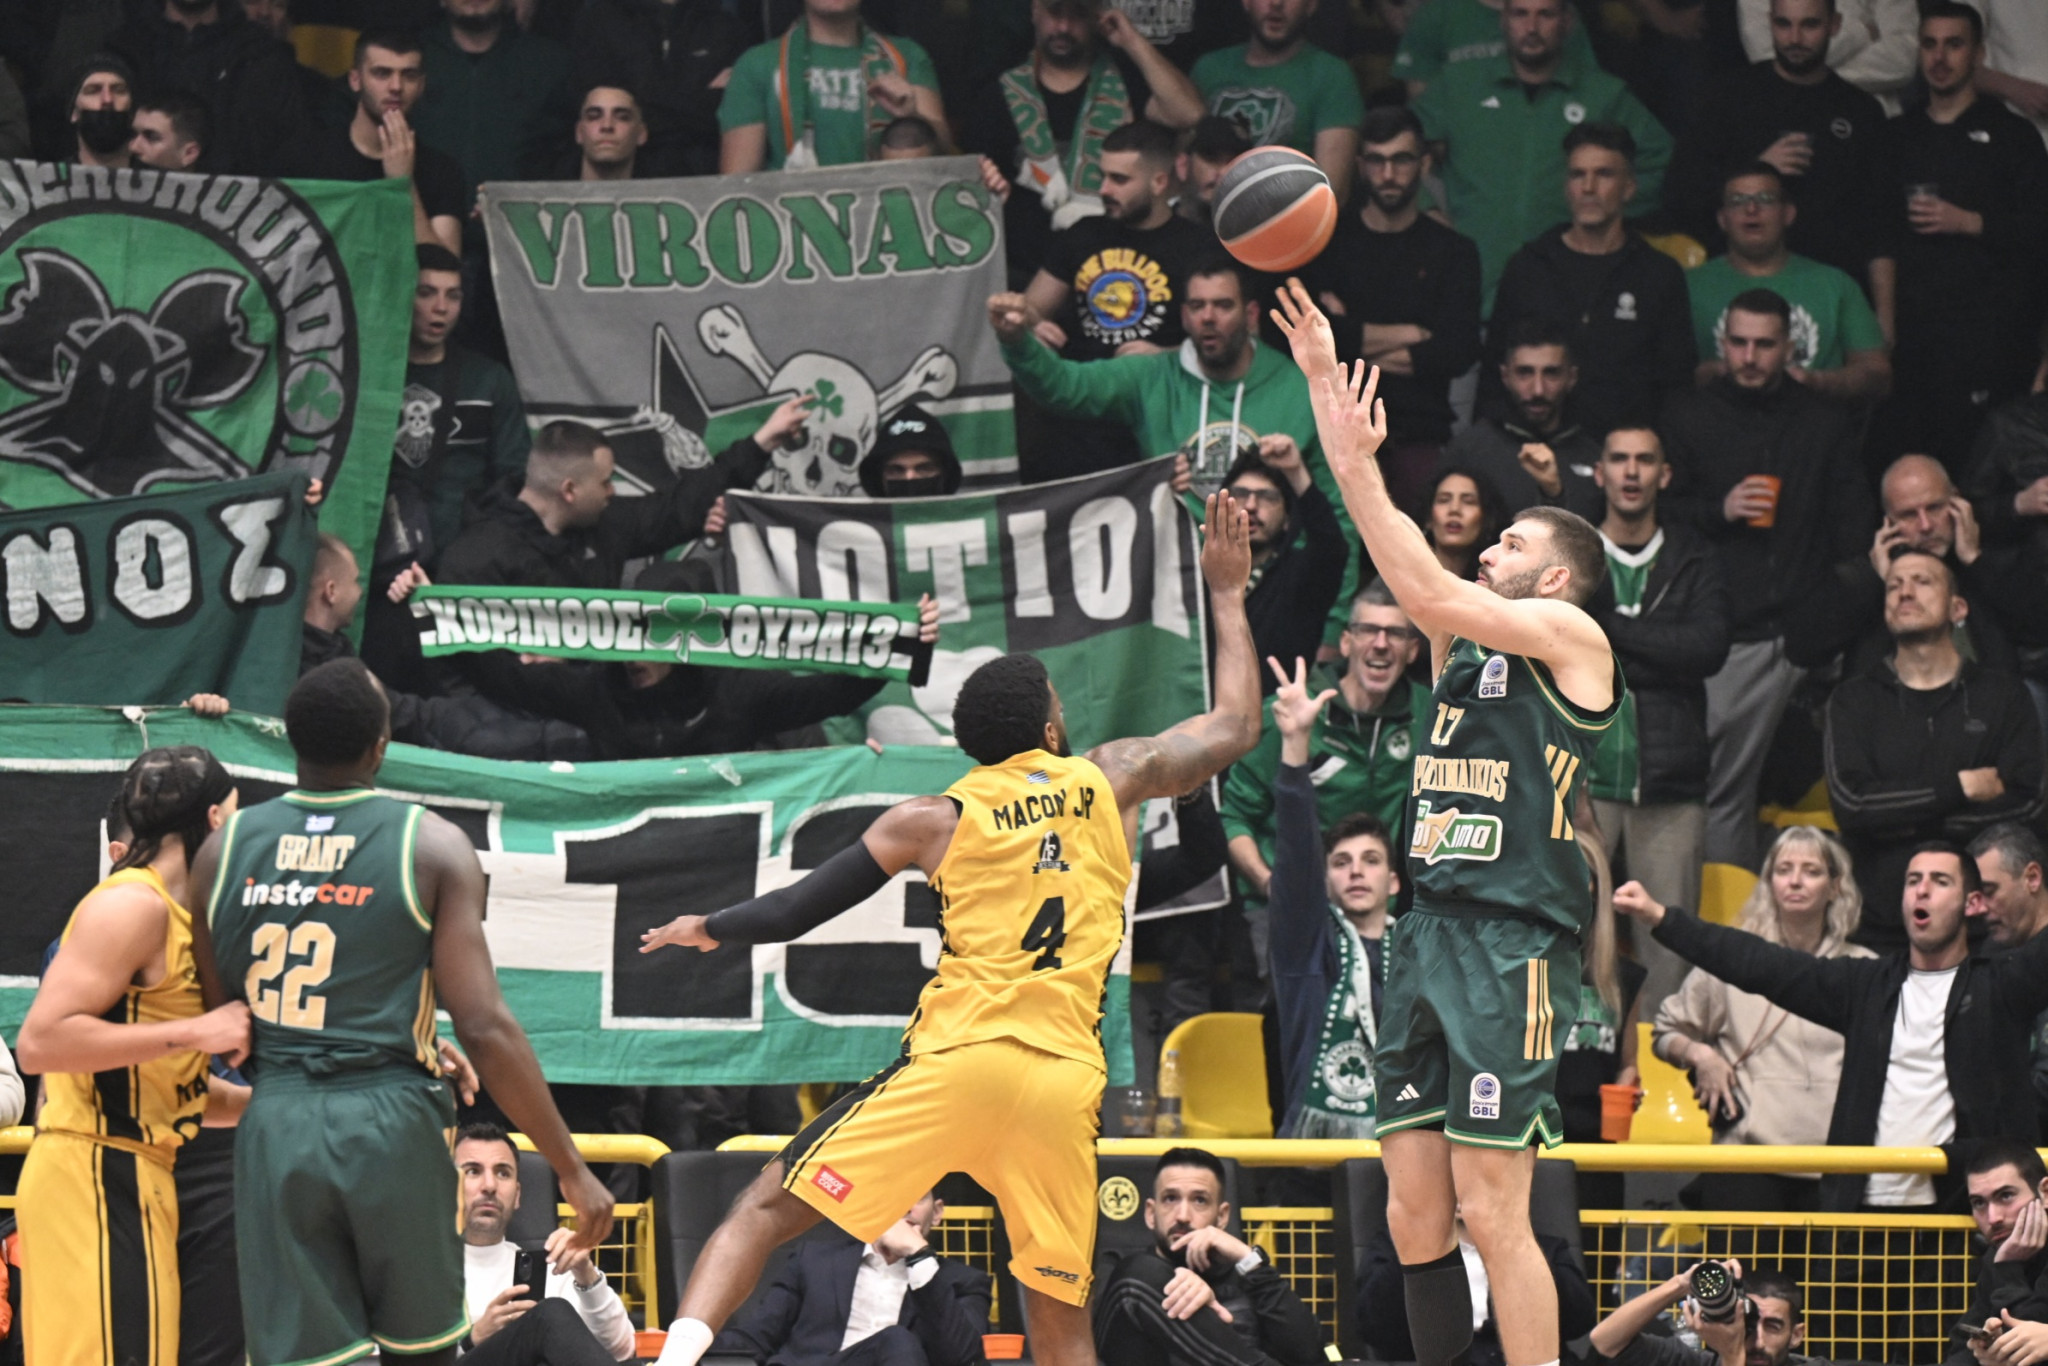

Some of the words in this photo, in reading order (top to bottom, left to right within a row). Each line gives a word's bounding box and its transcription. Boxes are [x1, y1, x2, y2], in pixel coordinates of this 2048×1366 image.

[499, 179, 999, 291] VIRONAS
[1100, 247, 1173, 303] BULLDOG
[1481, 686, 1504, 696] GBL
[1430, 702, 1466, 747] 17
[992, 788, 1067, 831] MACON
[1073, 786, 1096, 820] JR
[275, 833, 356, 873] GRANT
[241, 876, 374, 907] instacar
[1020, 895, 1068, 972] 4
[244, 920, 337, 1031] 22
[1472, 1106, 1496, 1116] GBL
[817, 1178, 840, 1196] COLA
